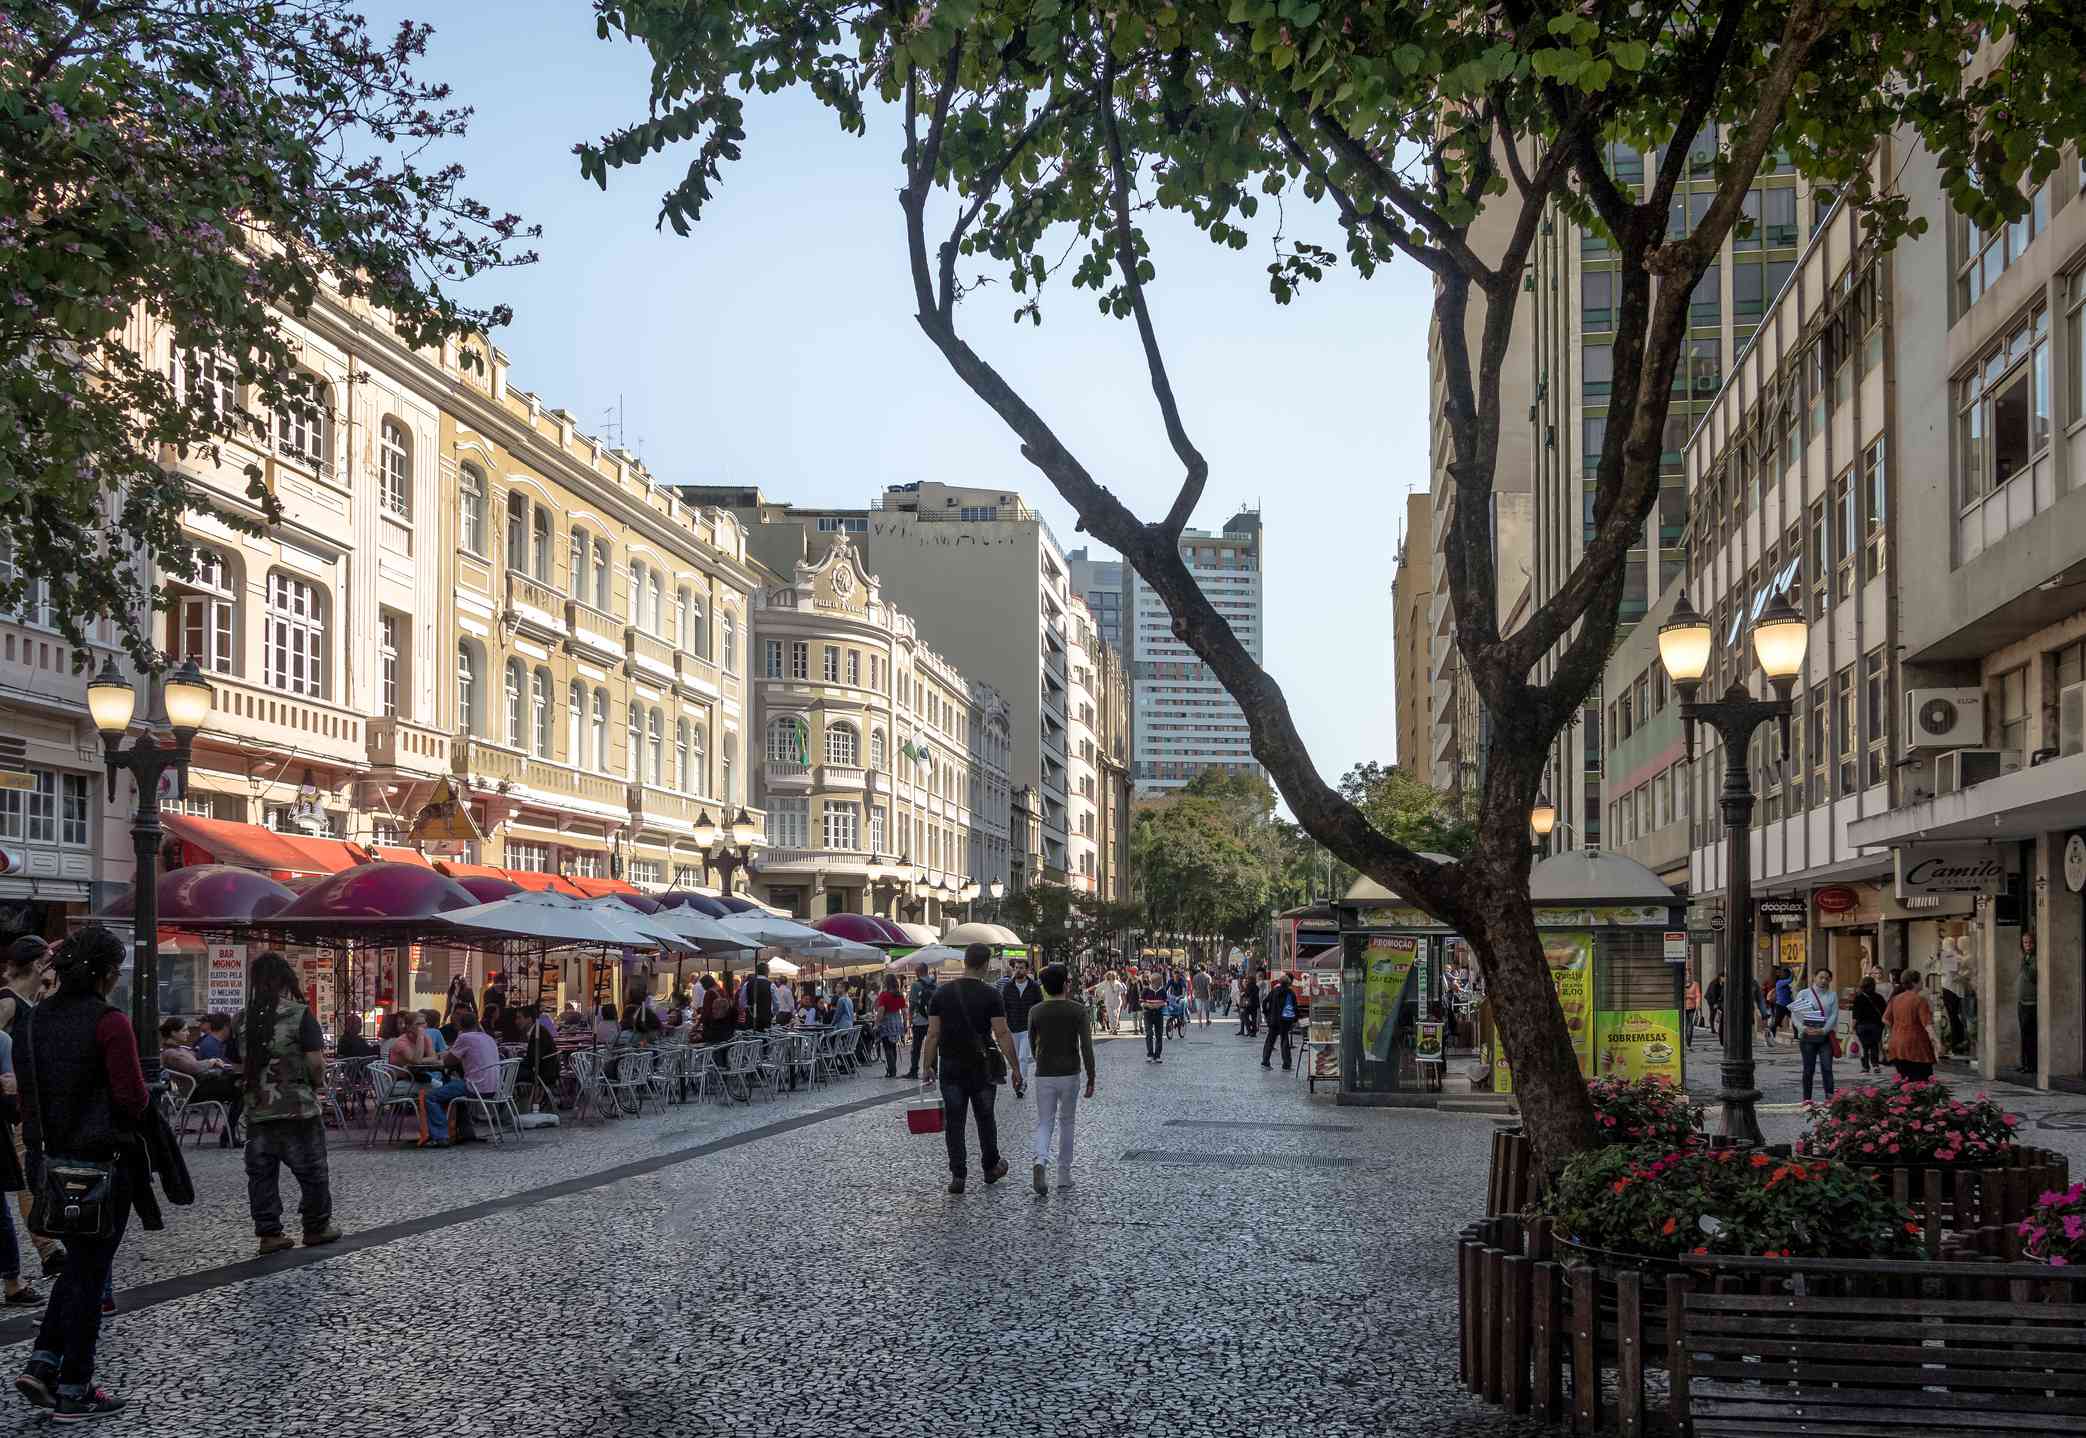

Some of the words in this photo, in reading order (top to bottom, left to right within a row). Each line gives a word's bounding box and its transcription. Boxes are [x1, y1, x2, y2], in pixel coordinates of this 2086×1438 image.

[1905, 858, 2003, 885] Camilo
[1373, 937, 1413, 950] PROMOÇÃO
[219, 949, 234, 958] BAR
[212, 959, 241, 969] MIGNON
[1607, 1033, 1667, 1042] SOBREMESAS
